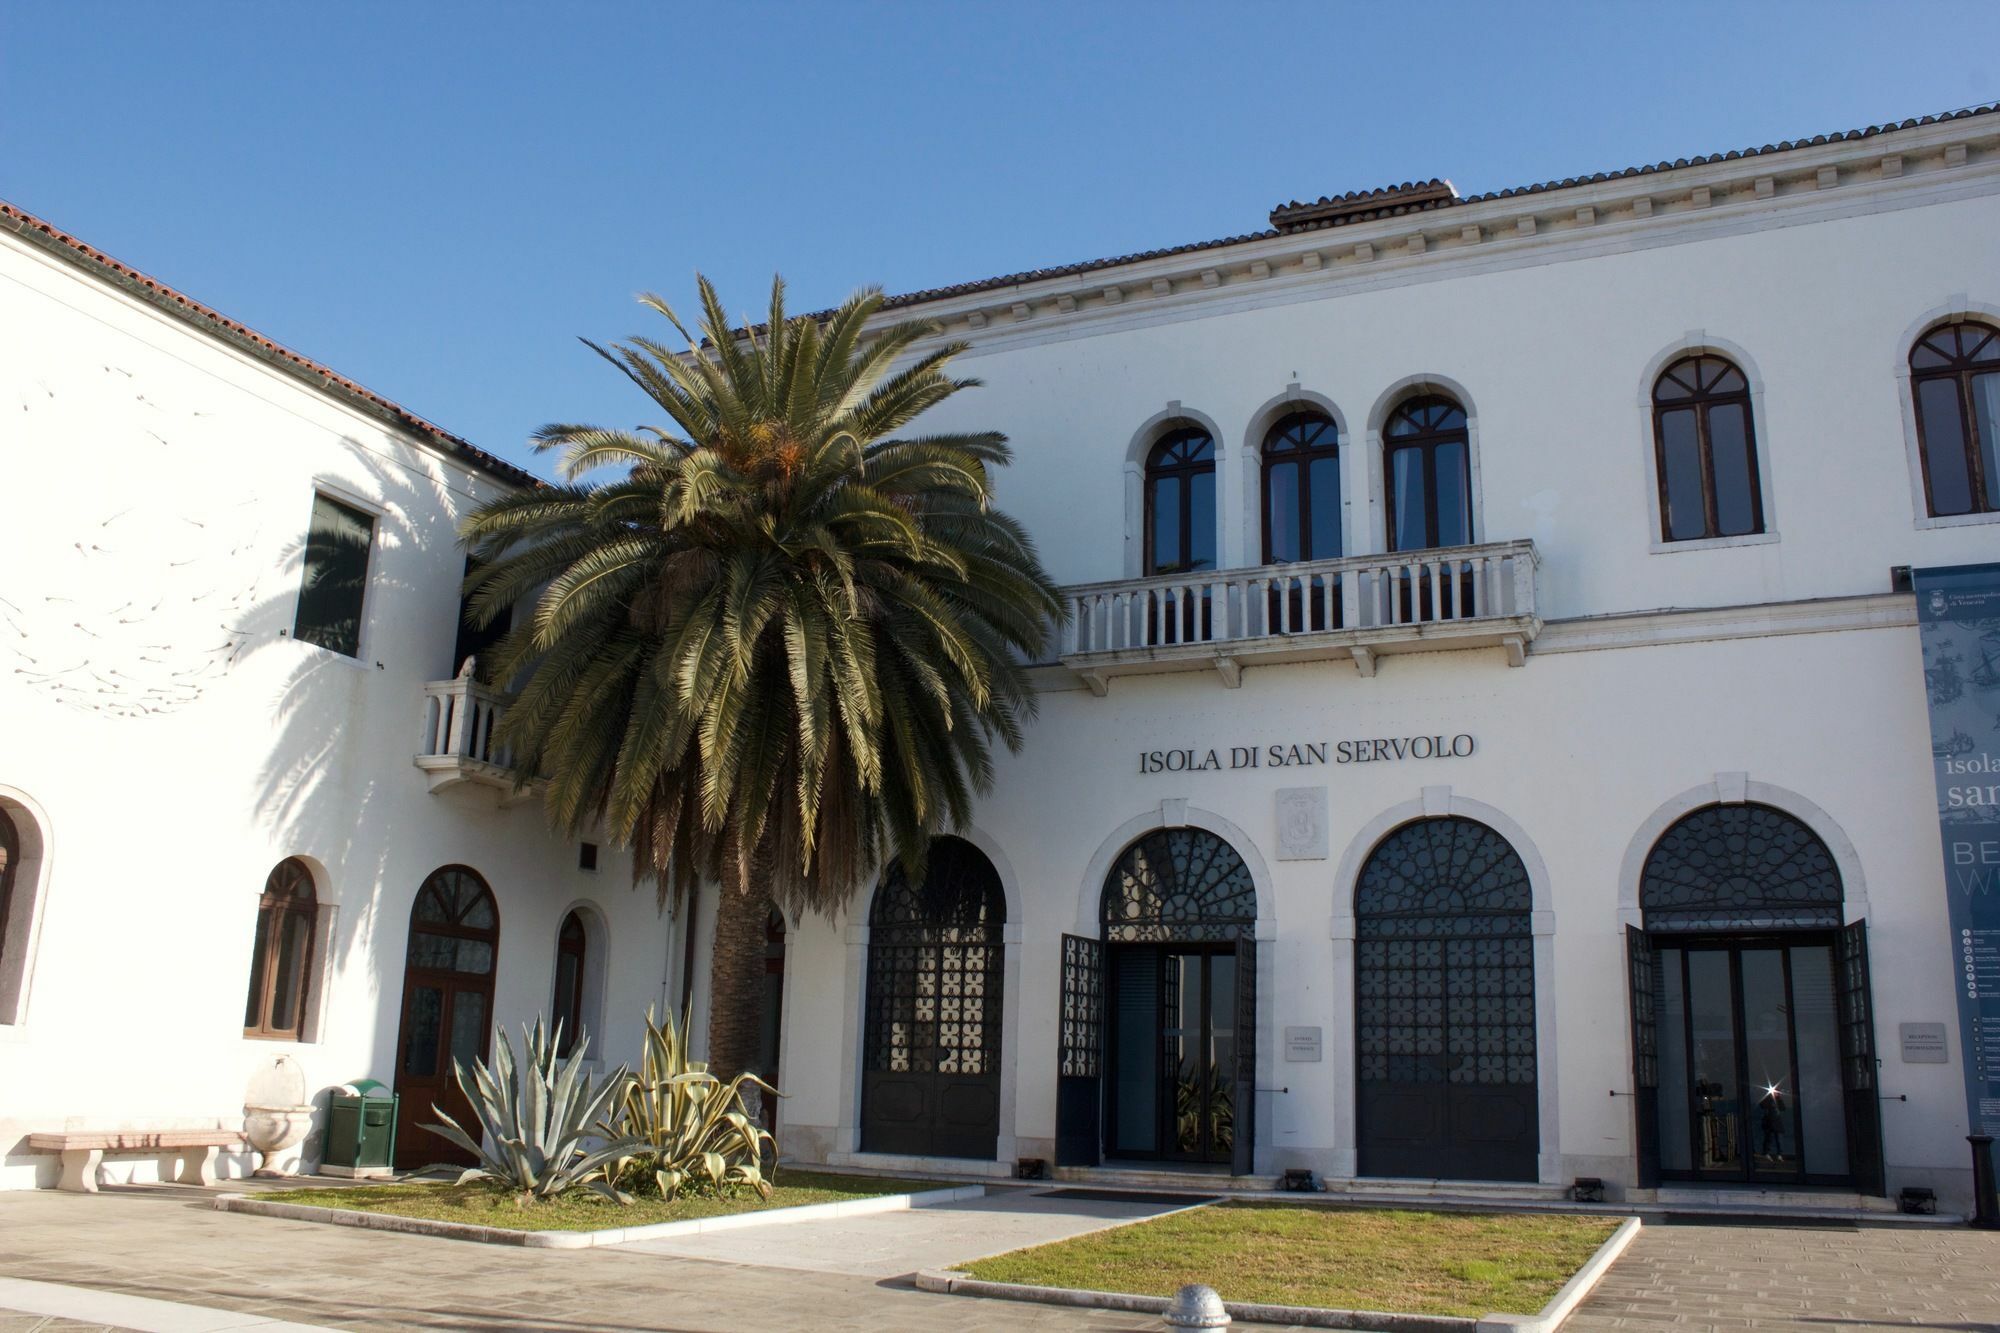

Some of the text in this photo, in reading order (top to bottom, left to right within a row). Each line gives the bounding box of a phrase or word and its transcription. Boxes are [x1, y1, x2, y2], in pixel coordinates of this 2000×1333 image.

[1139, 733, 1475, 774] ISOLA DI SAN SERVOLO
[1944, 752, 2000, 775] isola
[1952, 841, 2000, 865] BE
